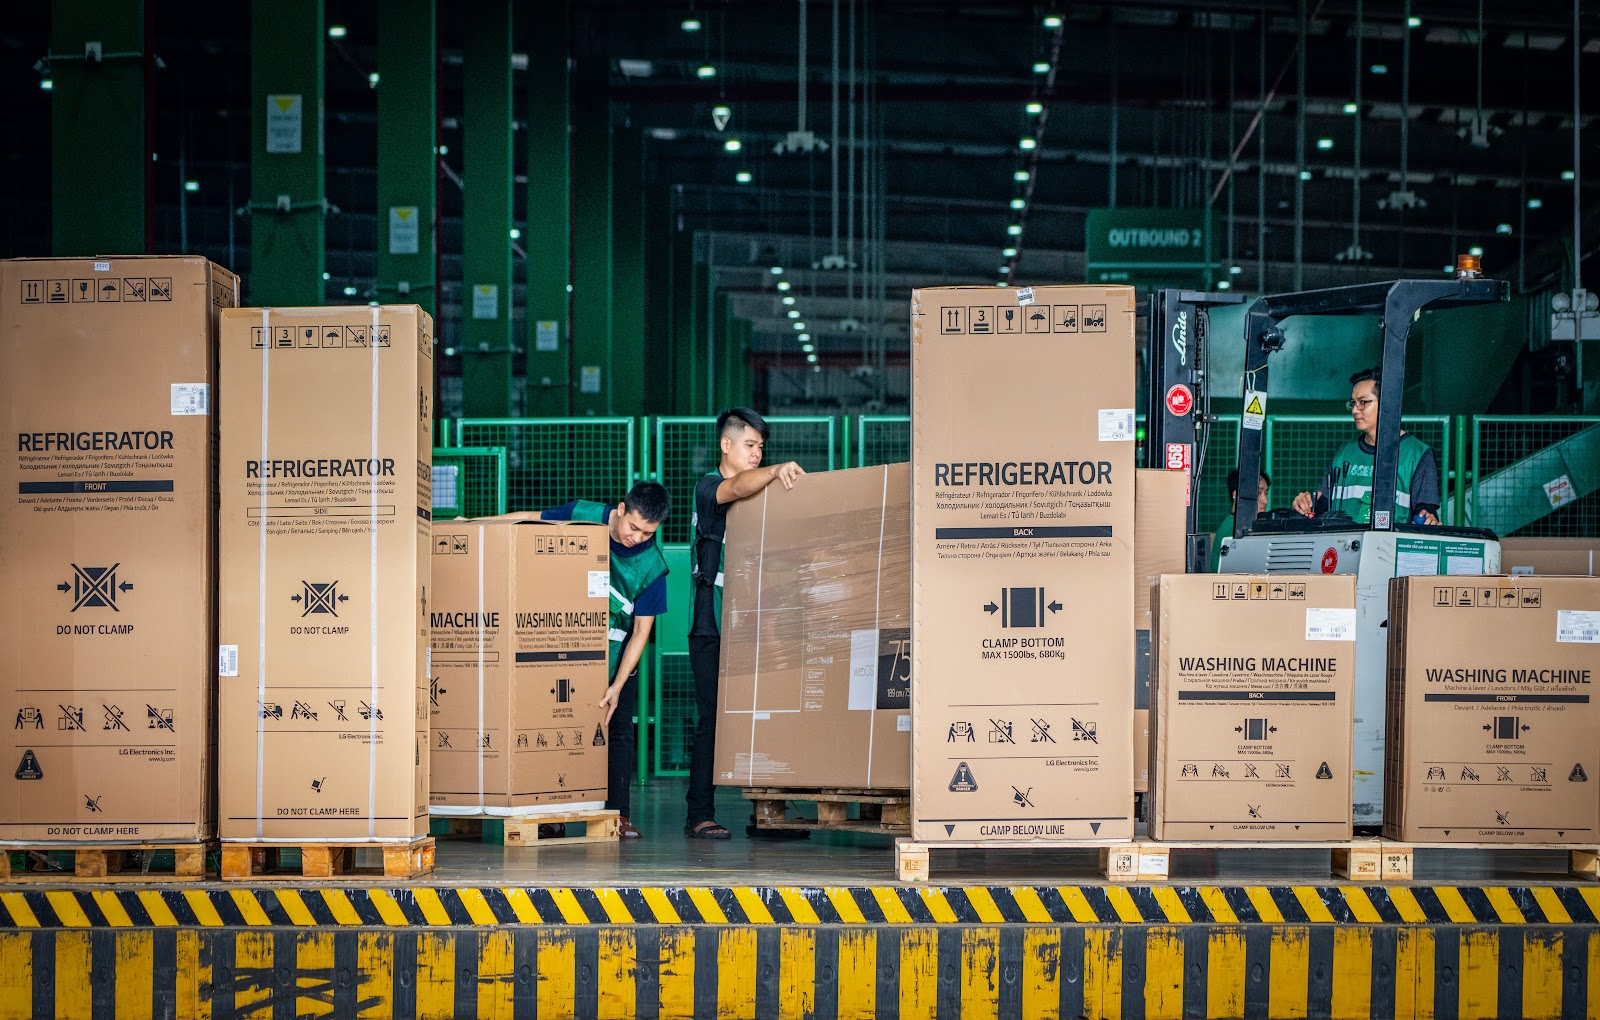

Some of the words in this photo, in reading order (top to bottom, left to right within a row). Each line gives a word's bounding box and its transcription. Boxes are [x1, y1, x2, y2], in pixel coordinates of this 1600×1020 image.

[1108, 228, 1189, 247] OUTBOUND
[1192, 228, 1202, 247] 2
[54, 282, 62, 294] 3
[978, 310, 985, 321] 3
[282, 328, 289, 339] 3
[1172, 311, 1187, 366] Linde
[18, 431, 174, 451] REFRIGERATOR
[1168, 445, 1183, 469] 058
[246, 458, 395, 478] REFRIGERATOR
[935, 461, 1112, 486] REFRIGERATOR
[84, 483, 107, 491] FRONT
[935, 492, 971, 500] Réfrigérateur
[976, 491, 1010, 499] Refrigerador
[936, 502, 979, 510] Холодильник
[984, 502, 1028, 510] холодильник
[1033, 501, 1063, 509] Sovutgich
[1237, 585, 1243, 593] 4
[1462, 590, 1468, 598] 4
[430, 612, 499, 628] MACHINE
[515, 613, 562, 628] WASHING
[565, 612, 606, 628] MACHINE
[56, 625, 72, 635] DO
[74, 625, 95, 635] NOT
[98, 625, 134, 634] CLAMP
[290, 626, 302, 635] DO
[304, 626, 320, 635] NOT
[322, 626, 349, 635] CLAMP
[982, 638, 1018, 649] CLAMP
[1020, 637, 1064, 648] BOTTOM
[889, 640, 910, 681] 75
[982, 651, 1001, 660] MAX
[1003, 650, 1037, 660] 1500lbs,
[1039, 650, 1065, 660] 680Kg
[1179, 657, 1256, 671] WASHING
[1262, 658, 1337, 672] MACHINE
[1426, 669, 1506, 683] WASHING
[1512, 670, 1591, 684] MACHINE
[980, 825, 1010, 836] CLAMP
[1012, 825, 1043, 835] BELOW
[1045, 825, 1065, 835] LINE
